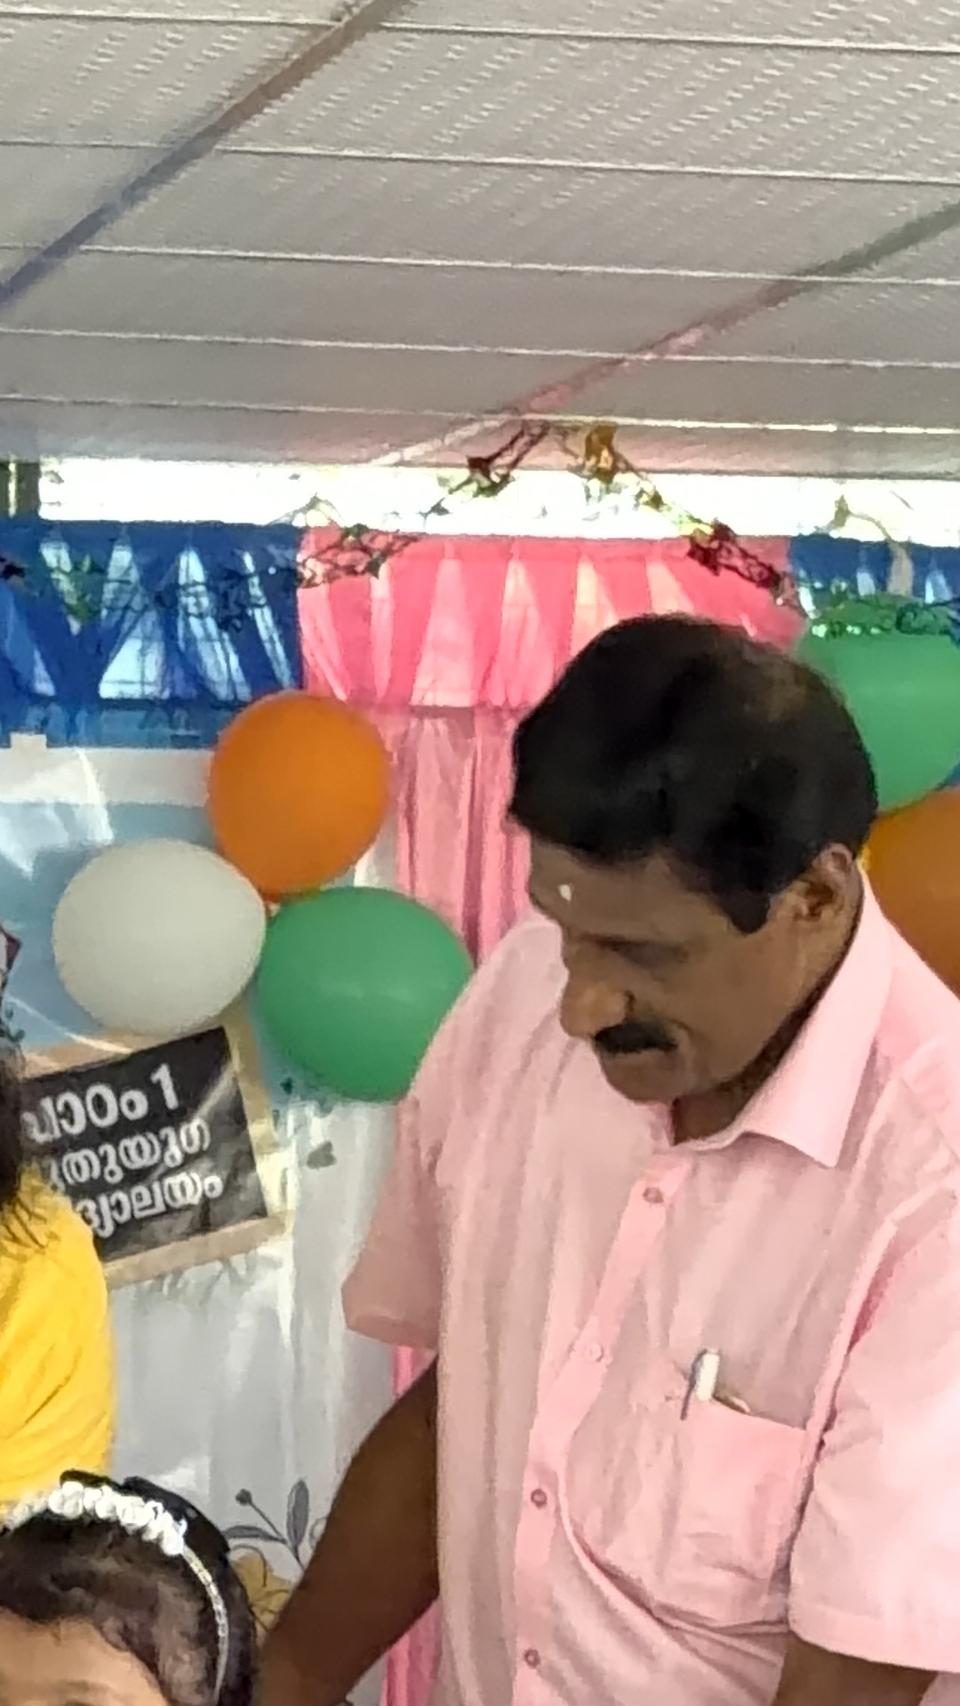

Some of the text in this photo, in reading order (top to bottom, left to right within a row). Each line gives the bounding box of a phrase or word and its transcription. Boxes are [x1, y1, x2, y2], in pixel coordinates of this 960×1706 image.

[21, 1063, 179, 1143] പാഠം 1
[76, 1171, 224, 1238] ദ്യാലയം
